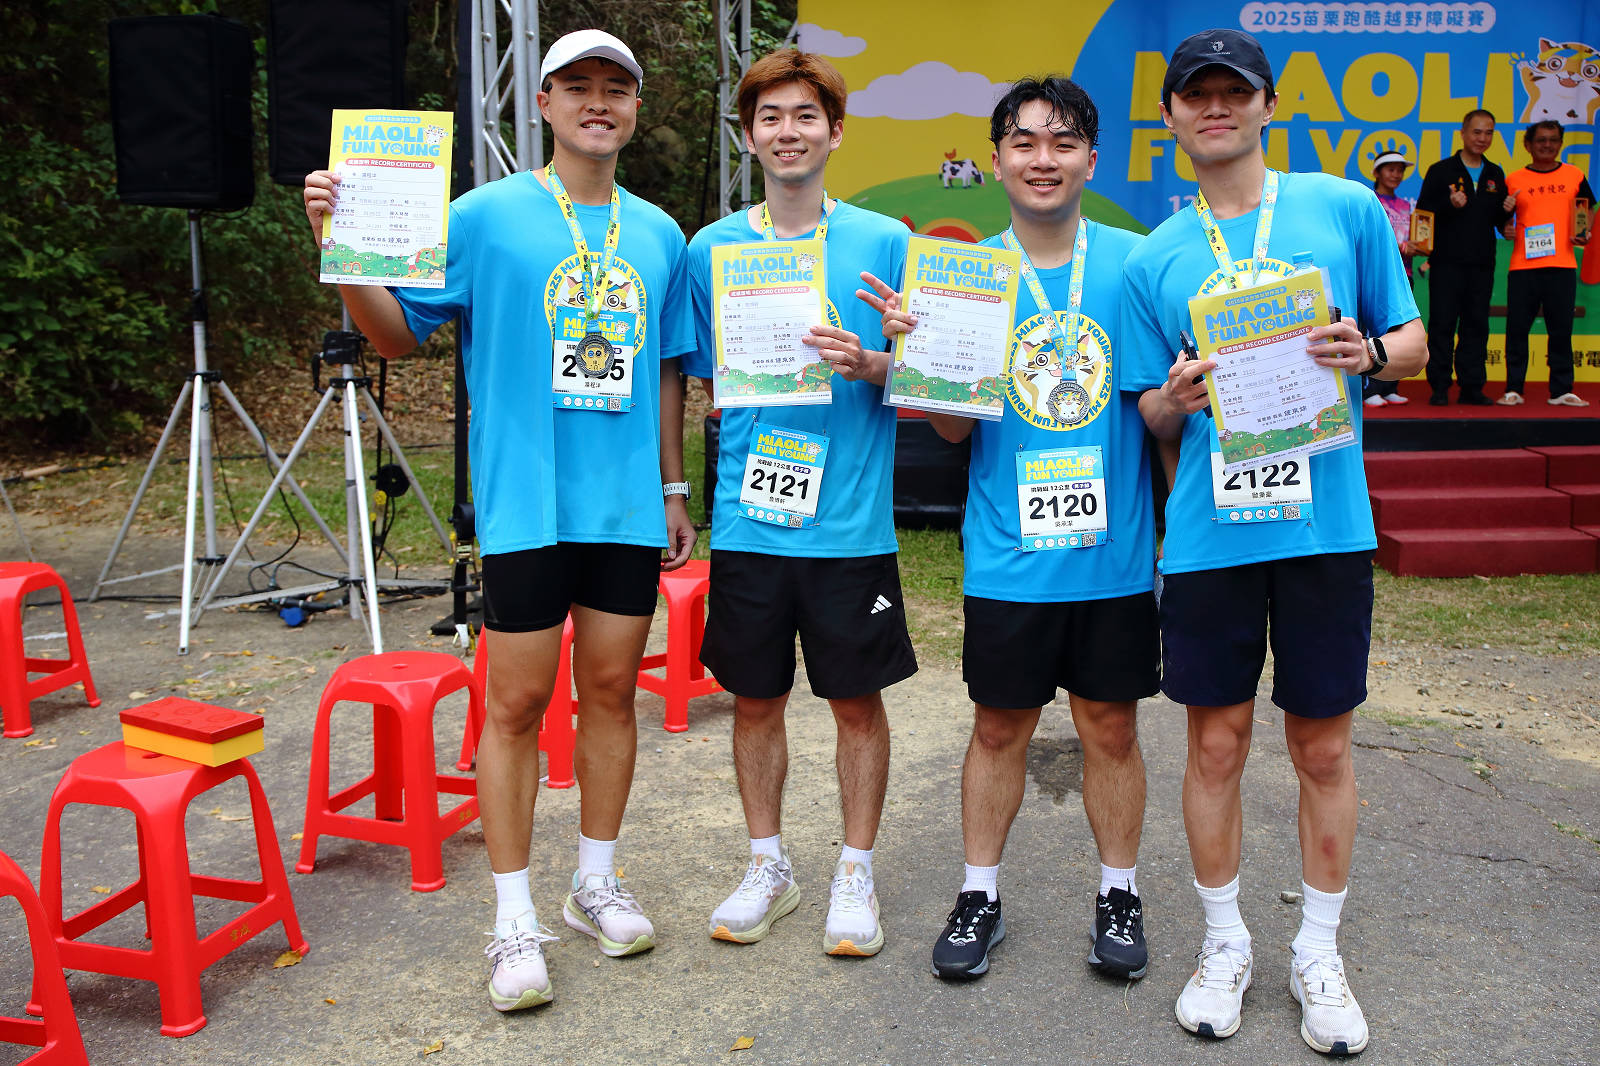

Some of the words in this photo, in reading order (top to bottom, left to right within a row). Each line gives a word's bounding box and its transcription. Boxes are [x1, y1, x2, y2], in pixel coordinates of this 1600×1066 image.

[1252, 9, 1485, 27] 2025苗栗跑酷越野障礙賽
[342, 125, 424, 142] MIAOLI
[341, 142, 376, 154] FUN
[380, 143, 440, 157] YOUNG
[396, 161, 432, 169] CERTIFICATE
[1528, 238, 1552, 249] 2164
[723, 256, 798, 275] MIAOLI
[917, 253, 995, 278] MIAOLI
[723, 273, 755, 286] FUN
[757, 270, 813, 285] YOUNG
[916, 269, 950, 285] FUN
[952, 273, 1008, 292] YOUNG
[944, 290, 966, 298] RECORD
[966, 292, 1000, 303] CERTIFICATE
[1204, 295, 1297, 331] MIAOLI
[1208, 325, 1252, 344] FUN
[1250, 307, 1316, 335] YOUNG
[1087, 321, 1112, 364] YOUNG
[1245, 338, 1271, 349] RECORD
[1271, 326, 1310, 343] CERTIFICATE
[1006, 376, 1032, 418] YOUNG
[1032, 413, 1058, 429] FUN
[757, 433, 808, 452] MIAOLI
[756, 443, 777, 456] FUN
[778, 448, 817, 464] YOUNG
[1025, 457, 1082, 473] MIAOLI
[1026, 471, 1050, 481] FUN
[1052, 468, 1094, 478] YOUNG
[750, 468, 809, 500] 2121
[1223, 461, 1301, 491] 2122
[1028, 493, 1098, 520] 2120
